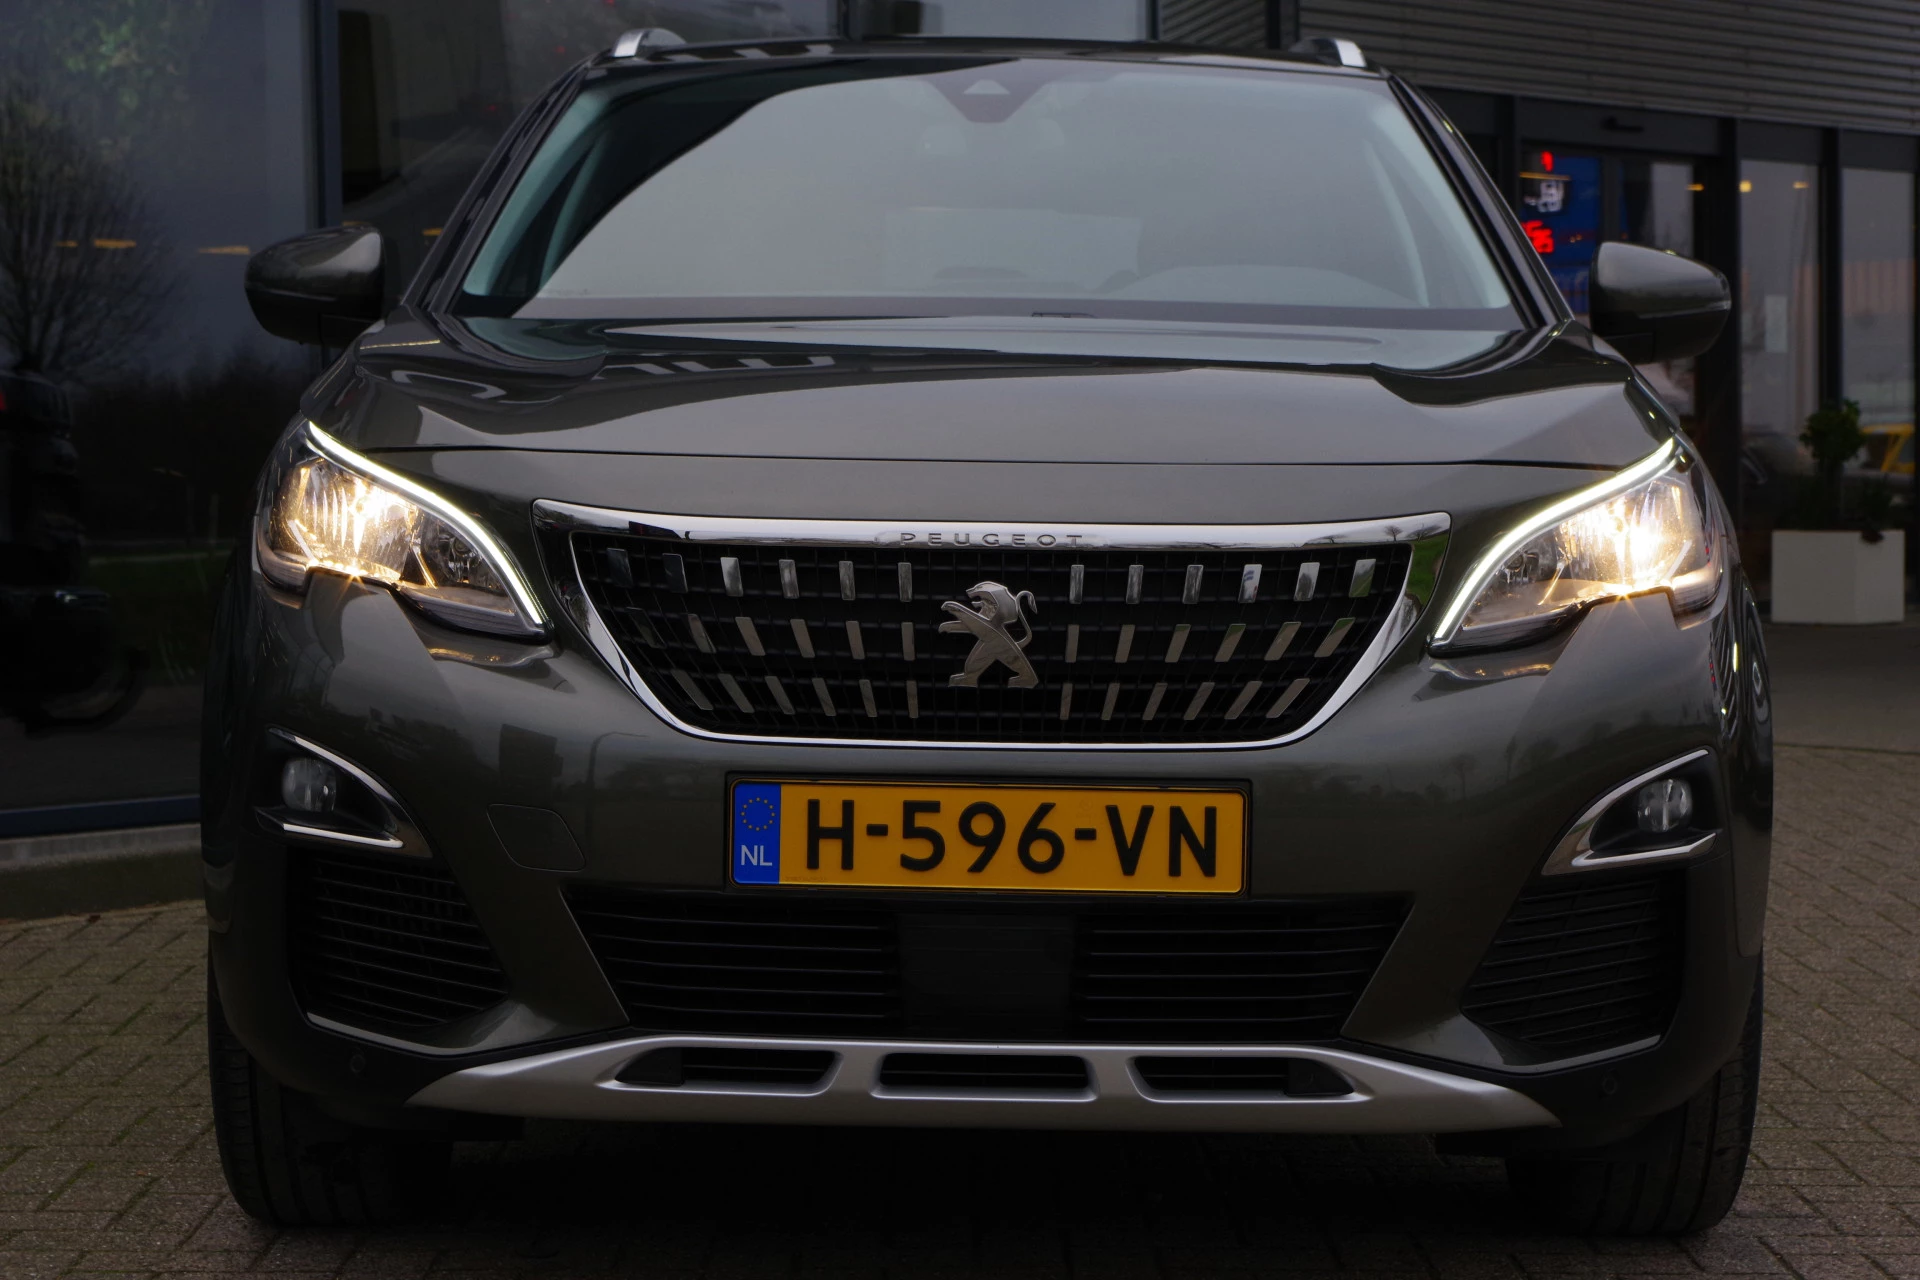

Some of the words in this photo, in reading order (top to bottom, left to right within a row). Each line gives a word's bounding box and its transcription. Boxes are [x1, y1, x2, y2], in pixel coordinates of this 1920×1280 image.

[900, 532, 1083, 548] PEUGEOT
[806, 798, 1217, 877] H-596-VN
[740, 844, 773, 867] NL
